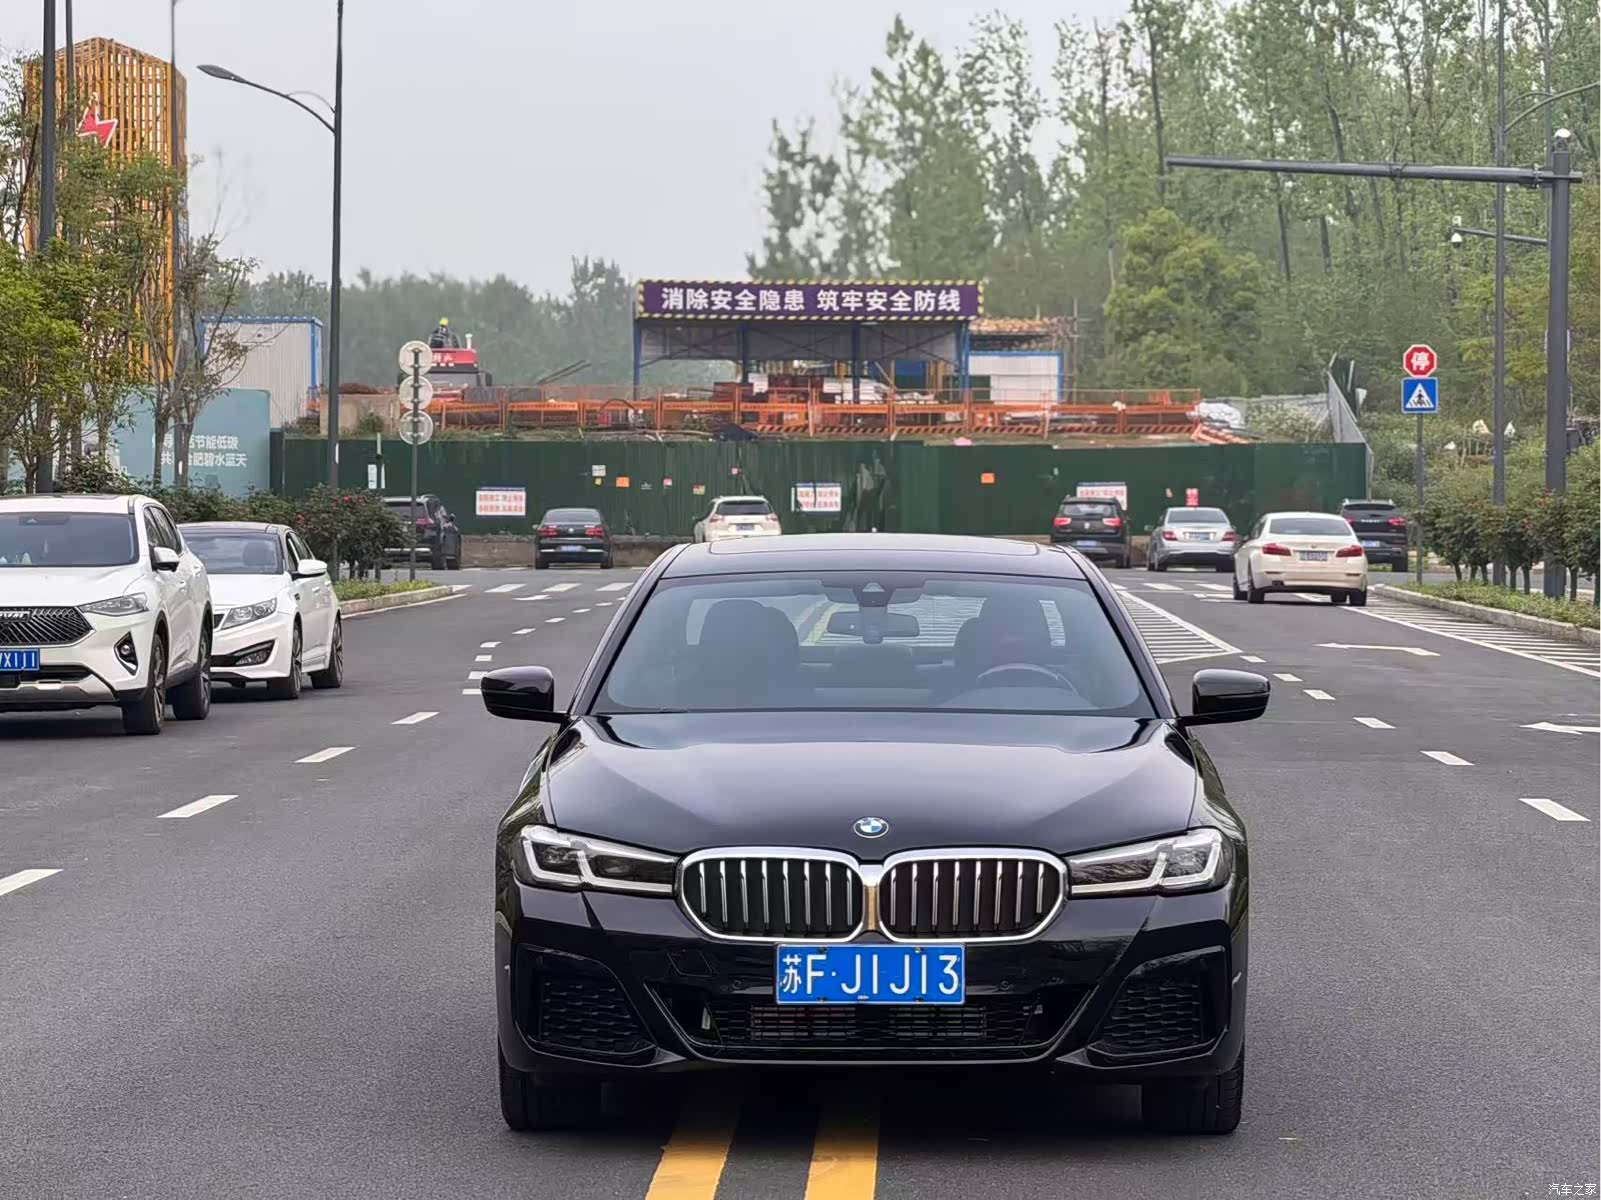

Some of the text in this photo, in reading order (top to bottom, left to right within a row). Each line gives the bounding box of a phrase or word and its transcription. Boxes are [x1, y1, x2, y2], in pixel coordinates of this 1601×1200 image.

[661, 287, 961, 312] 消除安全隐患 筑牢安全防线
[1411, 352, 1430, 370] 停
[779, 953, 960, 995] 苏F·J1J13
